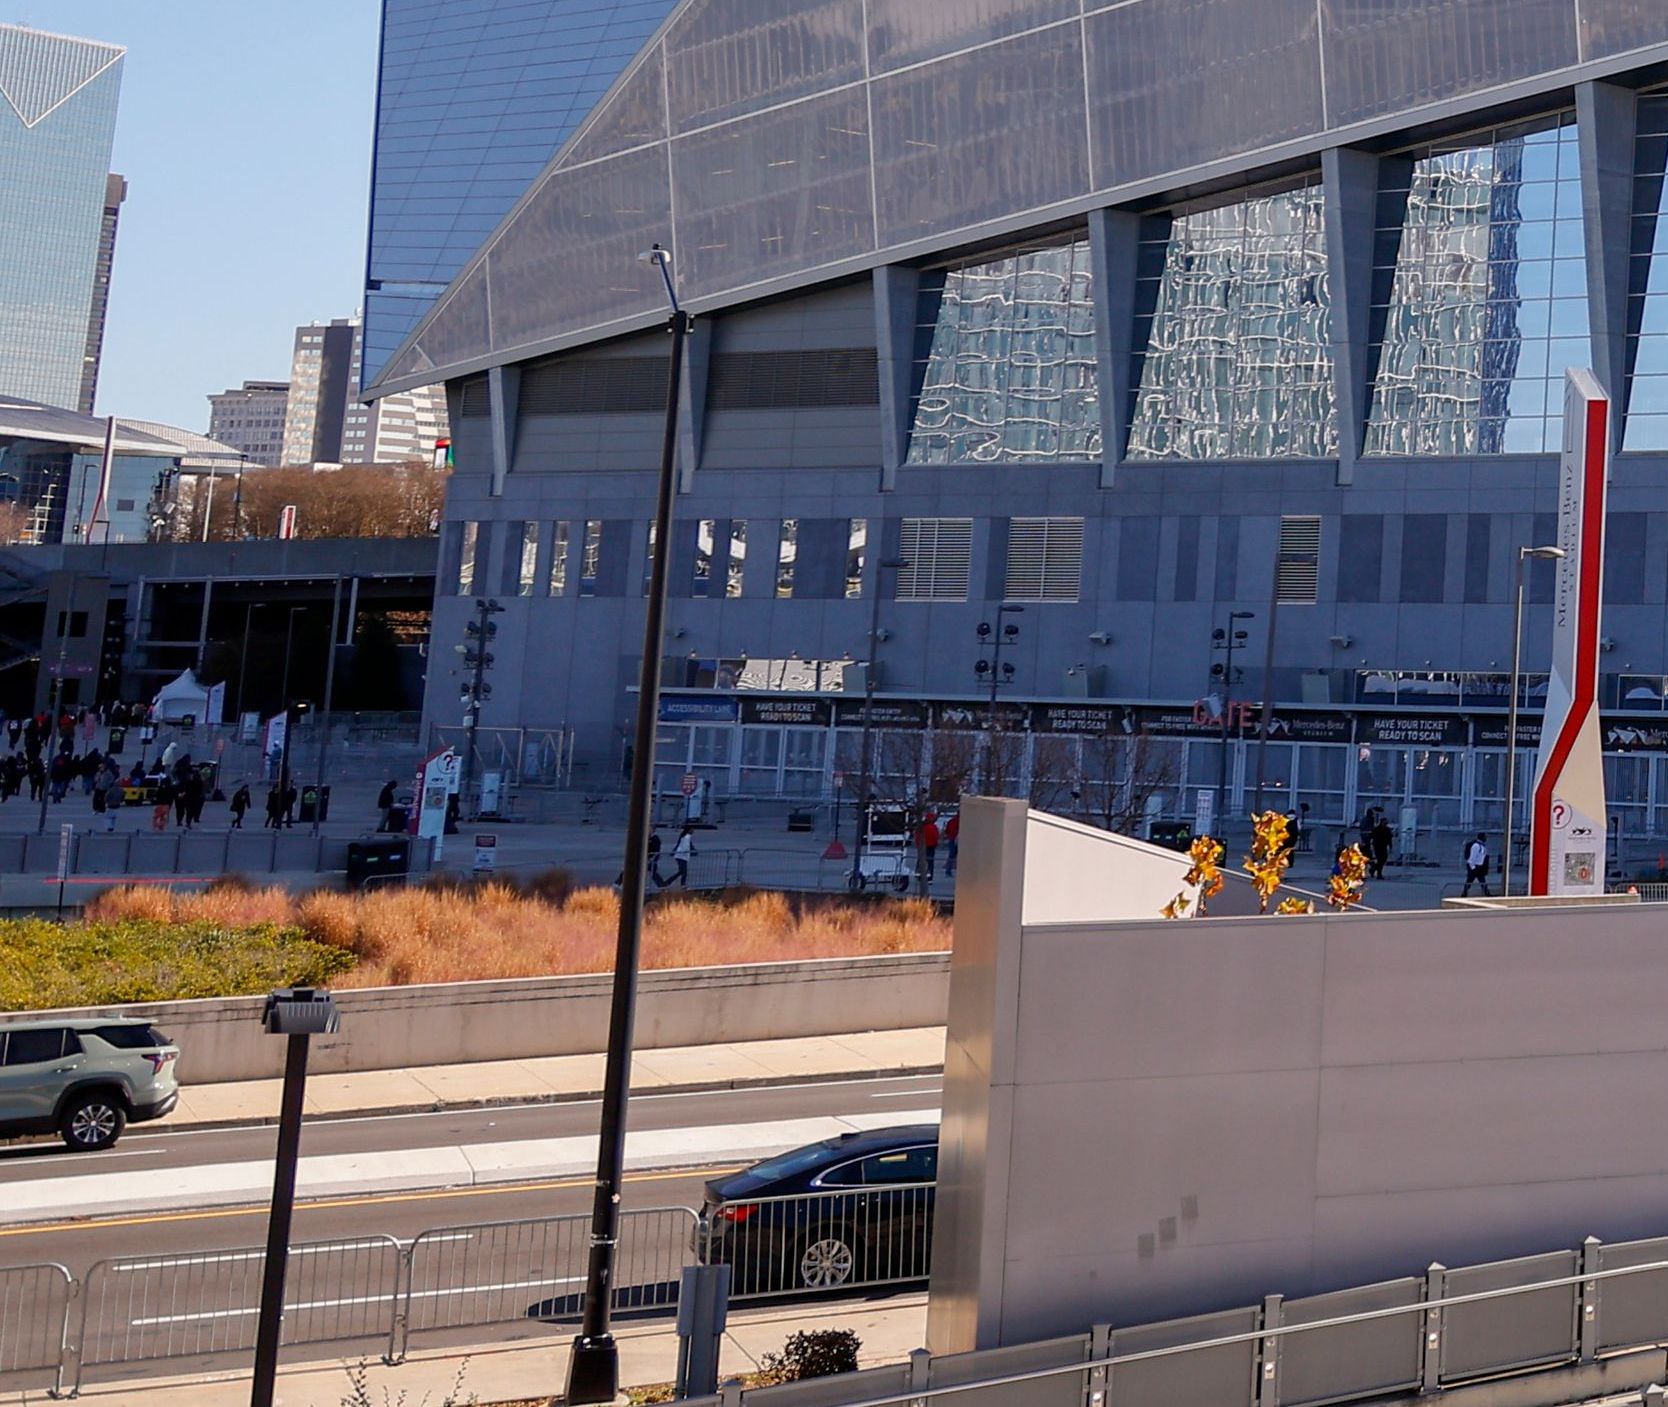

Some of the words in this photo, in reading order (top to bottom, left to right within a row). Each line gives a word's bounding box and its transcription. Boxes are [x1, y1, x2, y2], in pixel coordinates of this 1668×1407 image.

[1557, 465, 1573, 628] Mercedes-Benz
[755, 702, 773, 712] HAVE
[774, 702, 793, 712] YOUR
[793, 703, 817, 713] TICKET
[760, 712, 782, 721] READY
[792, 712, 812, 722] SCAN
[1048, 708, 1067, 719] HAVE
[1067, 709, 1087, 719] YOUR
[1087, 710, 1113, 720] TICKET
[1051, 719, 1077, 729] READY
[1087, 720, 1106, 730] SCAN
[1374, 718, 1396, 730] HAVE
[1397, 720, 1419, 730] YOUR
[1419, 720, 1449, 731] TICKET
[1378, 730, 1406, 740] READY
[1406, 730, 1418, 740] TO
[1418, 730, 1442, 741] SCAN
